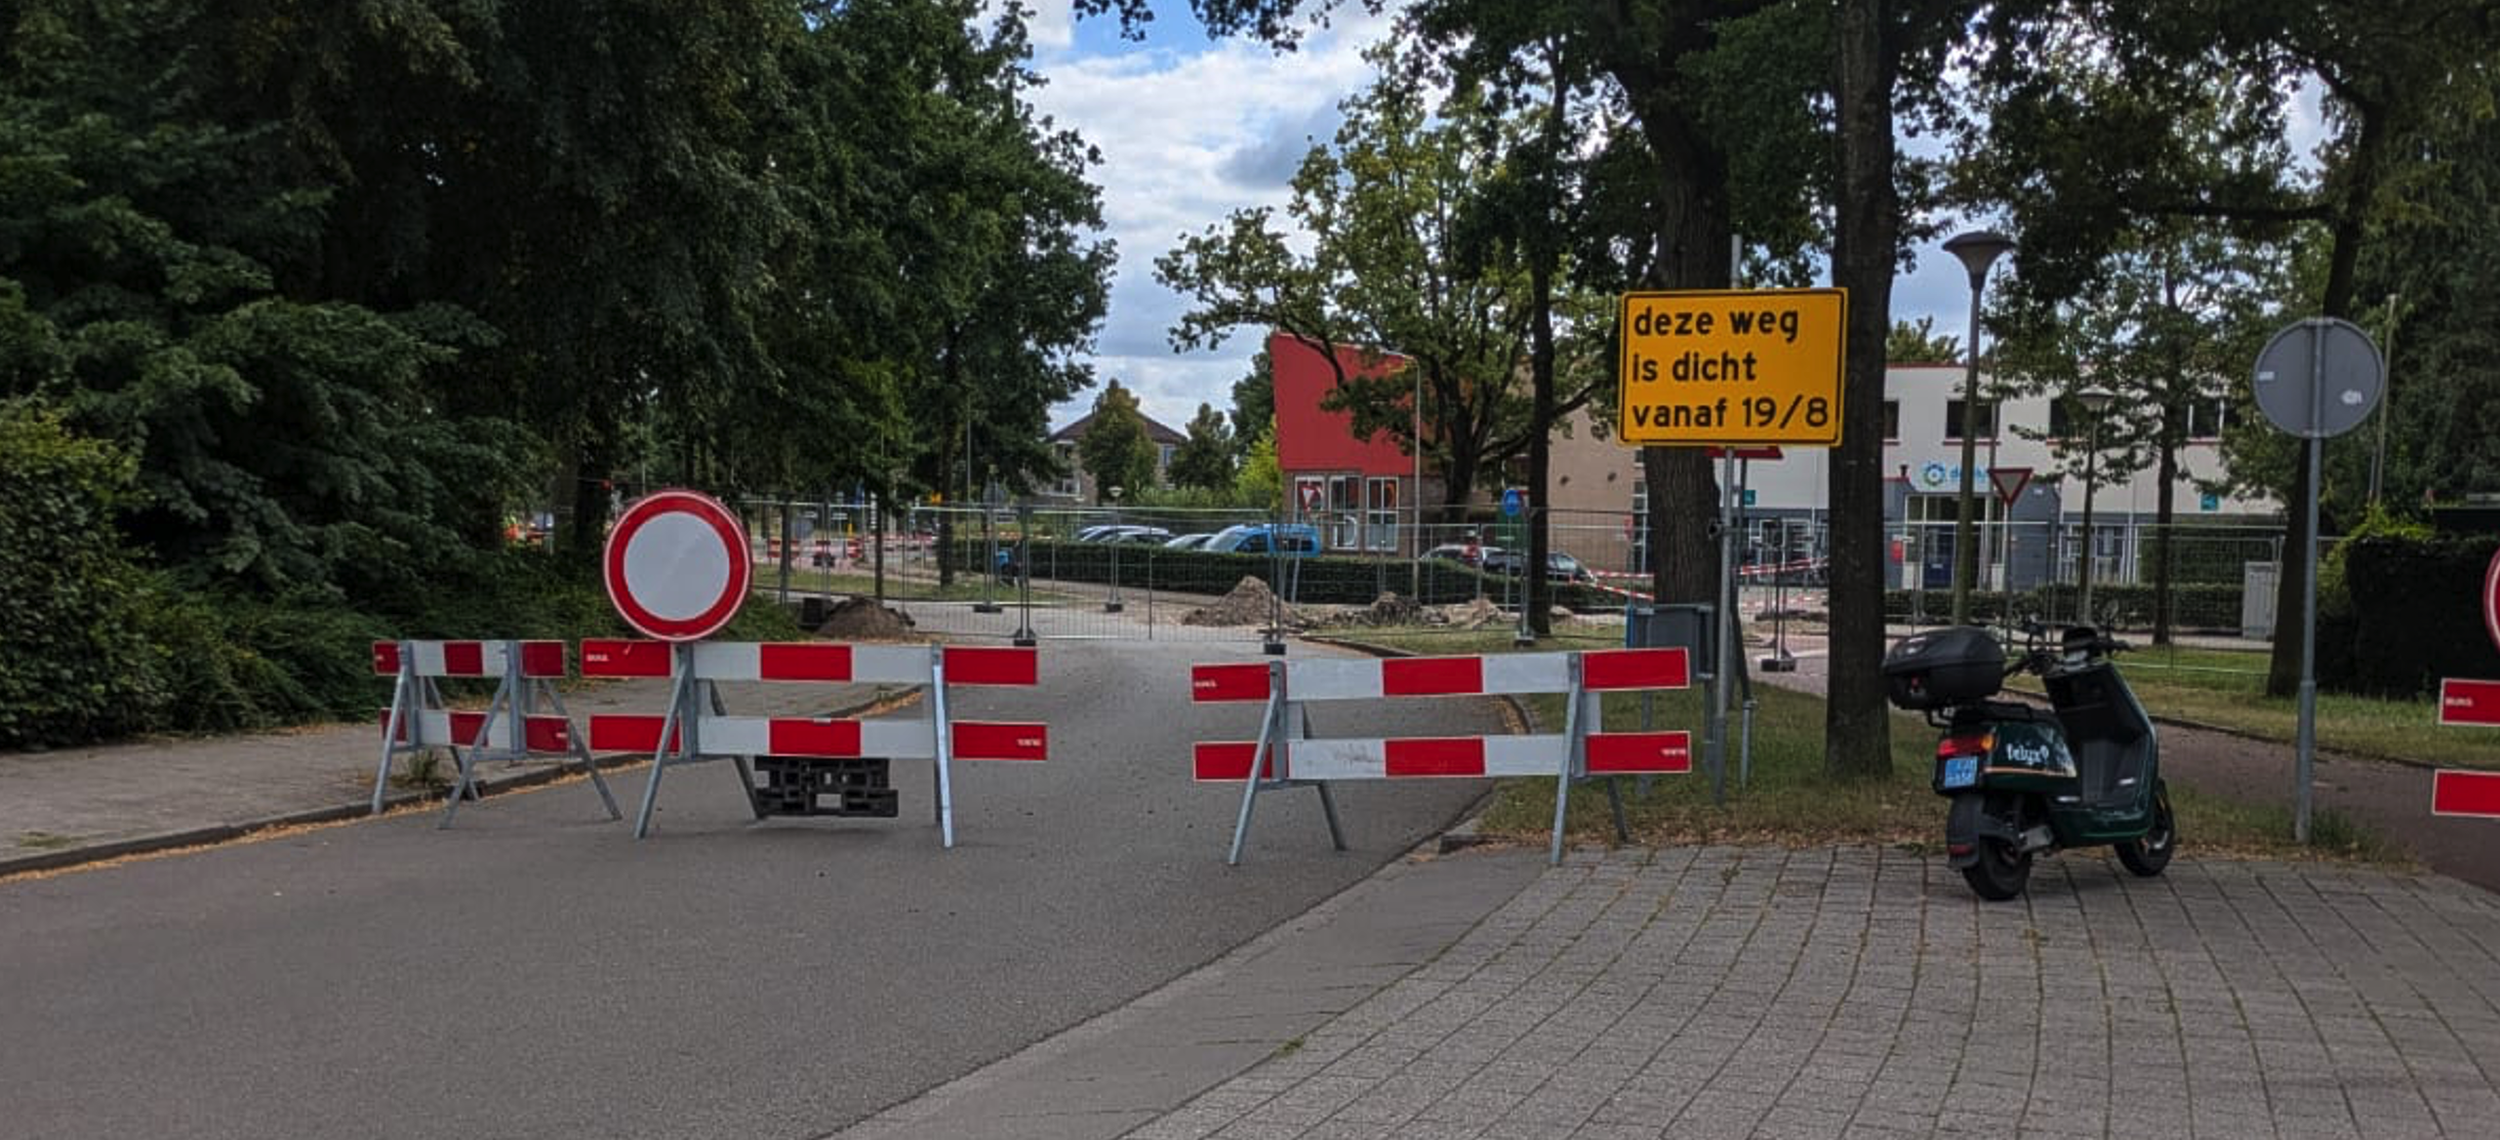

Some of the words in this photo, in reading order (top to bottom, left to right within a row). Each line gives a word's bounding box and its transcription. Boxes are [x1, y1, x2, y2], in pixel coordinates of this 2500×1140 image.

[1633, 306, 1714, 336] deze
[1729, 309, 1799, 343] weg
[1632, 353, 1658, 382] is
[1672, 351, 1758, 381] dicht
[1632, 397, 1727, 428] vanaf
[1742, 394, 1829, 429] 19/8
